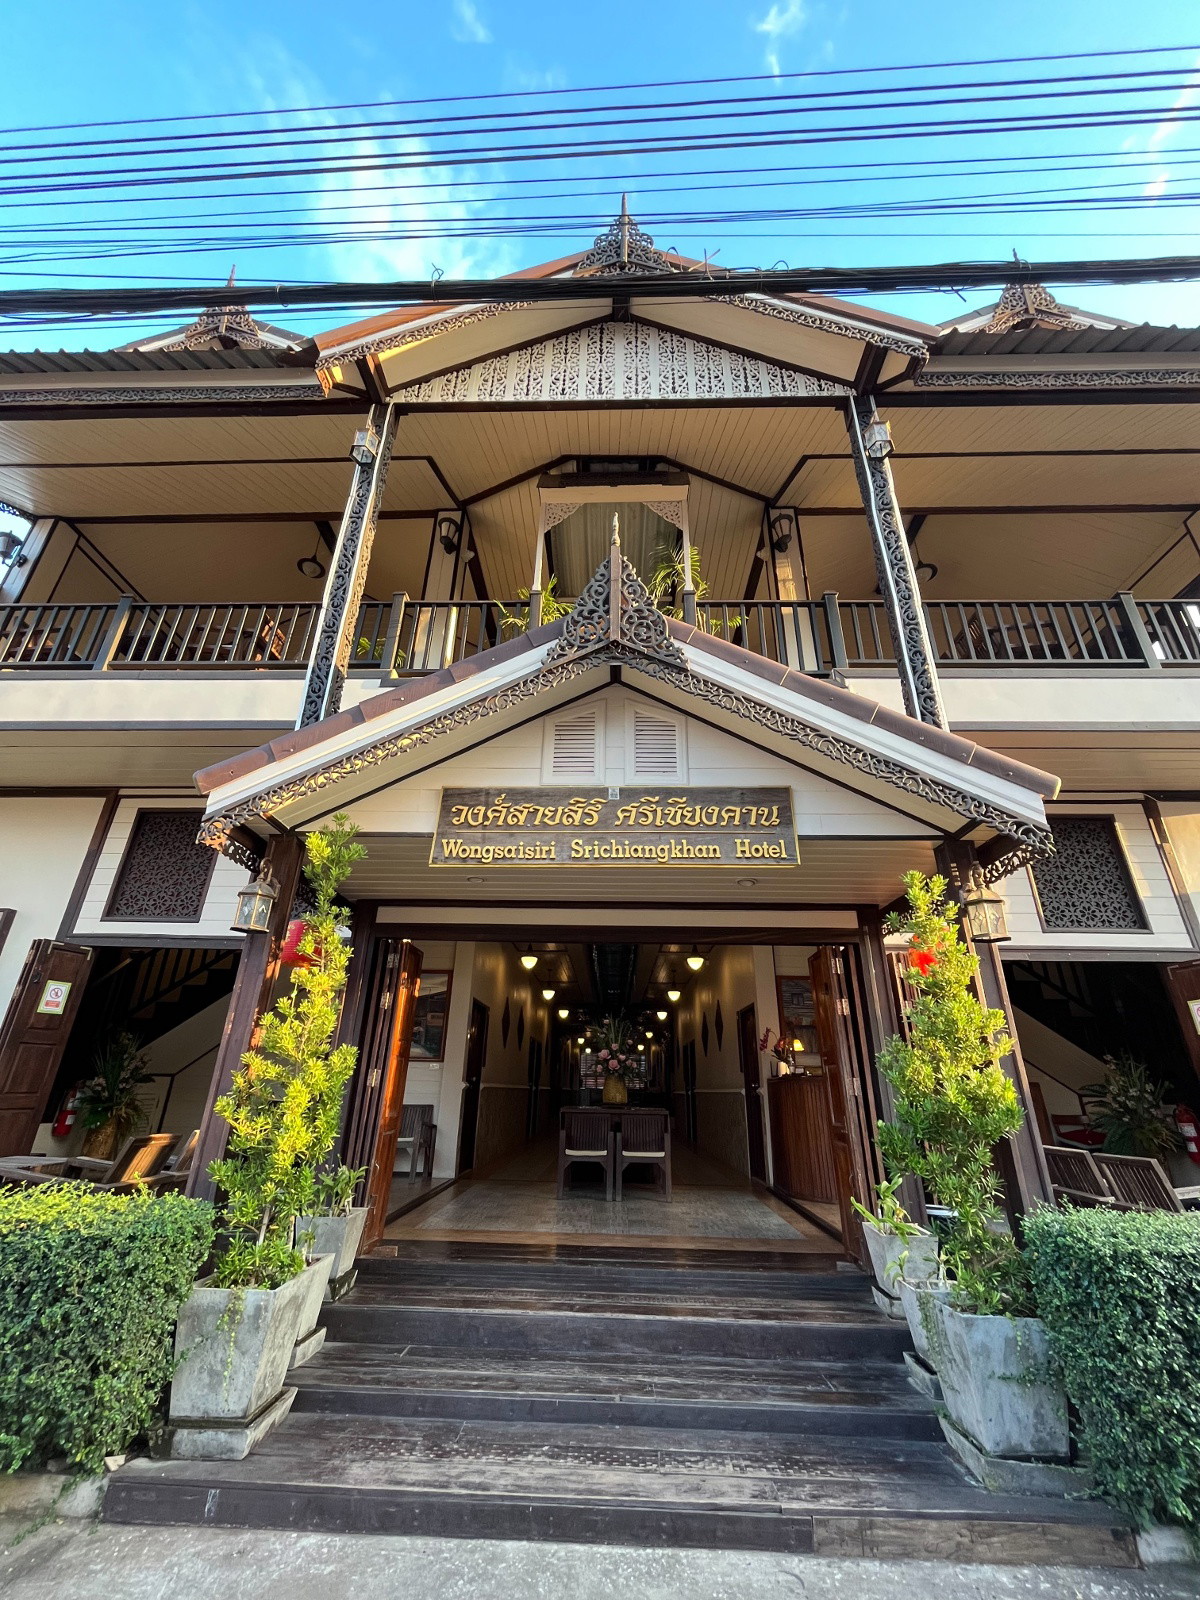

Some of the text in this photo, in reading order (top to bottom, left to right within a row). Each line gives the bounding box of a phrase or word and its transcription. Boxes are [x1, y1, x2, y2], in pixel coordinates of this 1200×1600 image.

[451, 793, 781, 827] วงศ์สายสิริ ศรีเชียงคาน
[441, 838, 788, 863] Wongsaisiri Srichiangkhan Hotel
